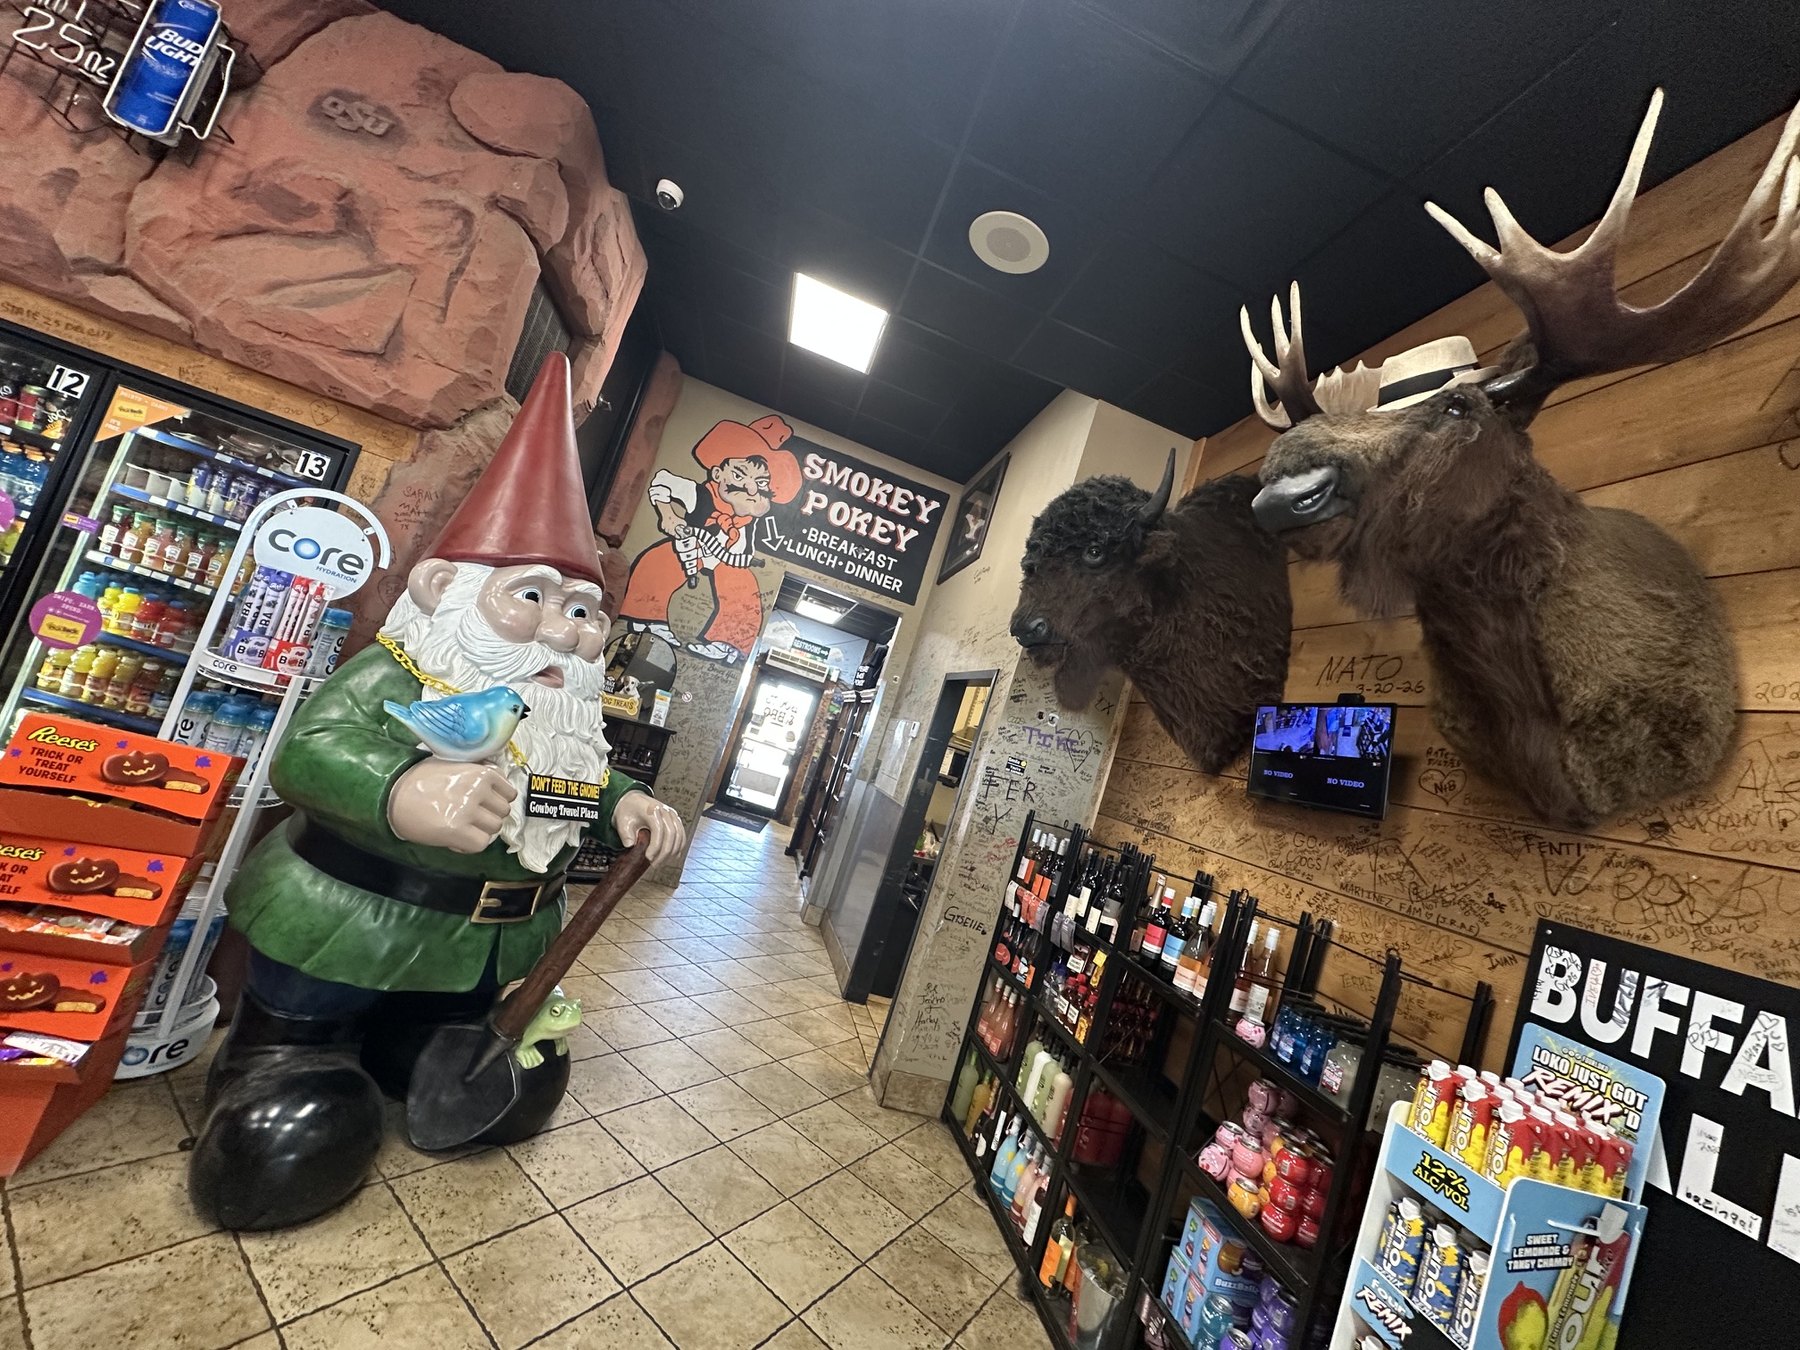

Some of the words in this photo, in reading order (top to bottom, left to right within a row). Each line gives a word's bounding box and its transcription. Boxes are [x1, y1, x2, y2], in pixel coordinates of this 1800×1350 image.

[12, 6, 93, 63] 25
[157, 28, 205, 54] BUD
[144, 36, 204, 67] LIGHT
[52, 367, 85, 396] 12
[298, 452, 326, 479] 13
[803, 452, 941, 525] SMOKEY
[801, 489, 919, 553] POKEY
[268, 528, 364, 576] core
[806, 526, 898, 571] BREAKFAST
[315, 565, 358, 584] HYDRATION
[787, 538, 838, 569] LUNCH
[844, 561, 903, 593] DINNER
[212, 658, 238, 673] core
[1316, 653, 1404, 687] NATO
[28, 726, 101, 752] Reese's
[30, 746, 64, 761] TRICK
[66, 752, 84, 764] OR
[34, 757, 70, 773] TREAT
[18, 765, 77, 784] YOURSELF
[530, 774, 550, 793] DON'T
[551, 778, 566, 795] FEED
[567, 780, 579, 797] THE
[1273, 770, 1294, 779] VIDEO
[1327, 777, 1338, 785] NO
[1339, 779, 1365, 789] VIDEO
[558, 804, 580, 818] Travel
[580, 806, 599, 820] Plaza
[10, 863, 29, 876] OR
[1530, 943, 1800, 1120] BUFFA
[1531, 1044, 1570, 1076] LOKO
[1570, 1059, 1611, 1097] JUST
[1610, 1079, 1649, 1112] GOT
[1421, 1151, 1470, 1196] 12%
[1412, 1166, 1471, 1213] ALC/VOL
[1513, 1245, 1560, 1258] LEMONADE
[1562, 1245, 1570, 1255] &
[1526, 1233, 1559, 1245] SWEET
[1507, 1259, 1537, 1271] TANGY
[1537, 1256, 1574, 1269] CHAMOY
[1355, 1285, 1413, 1340] REMIX
